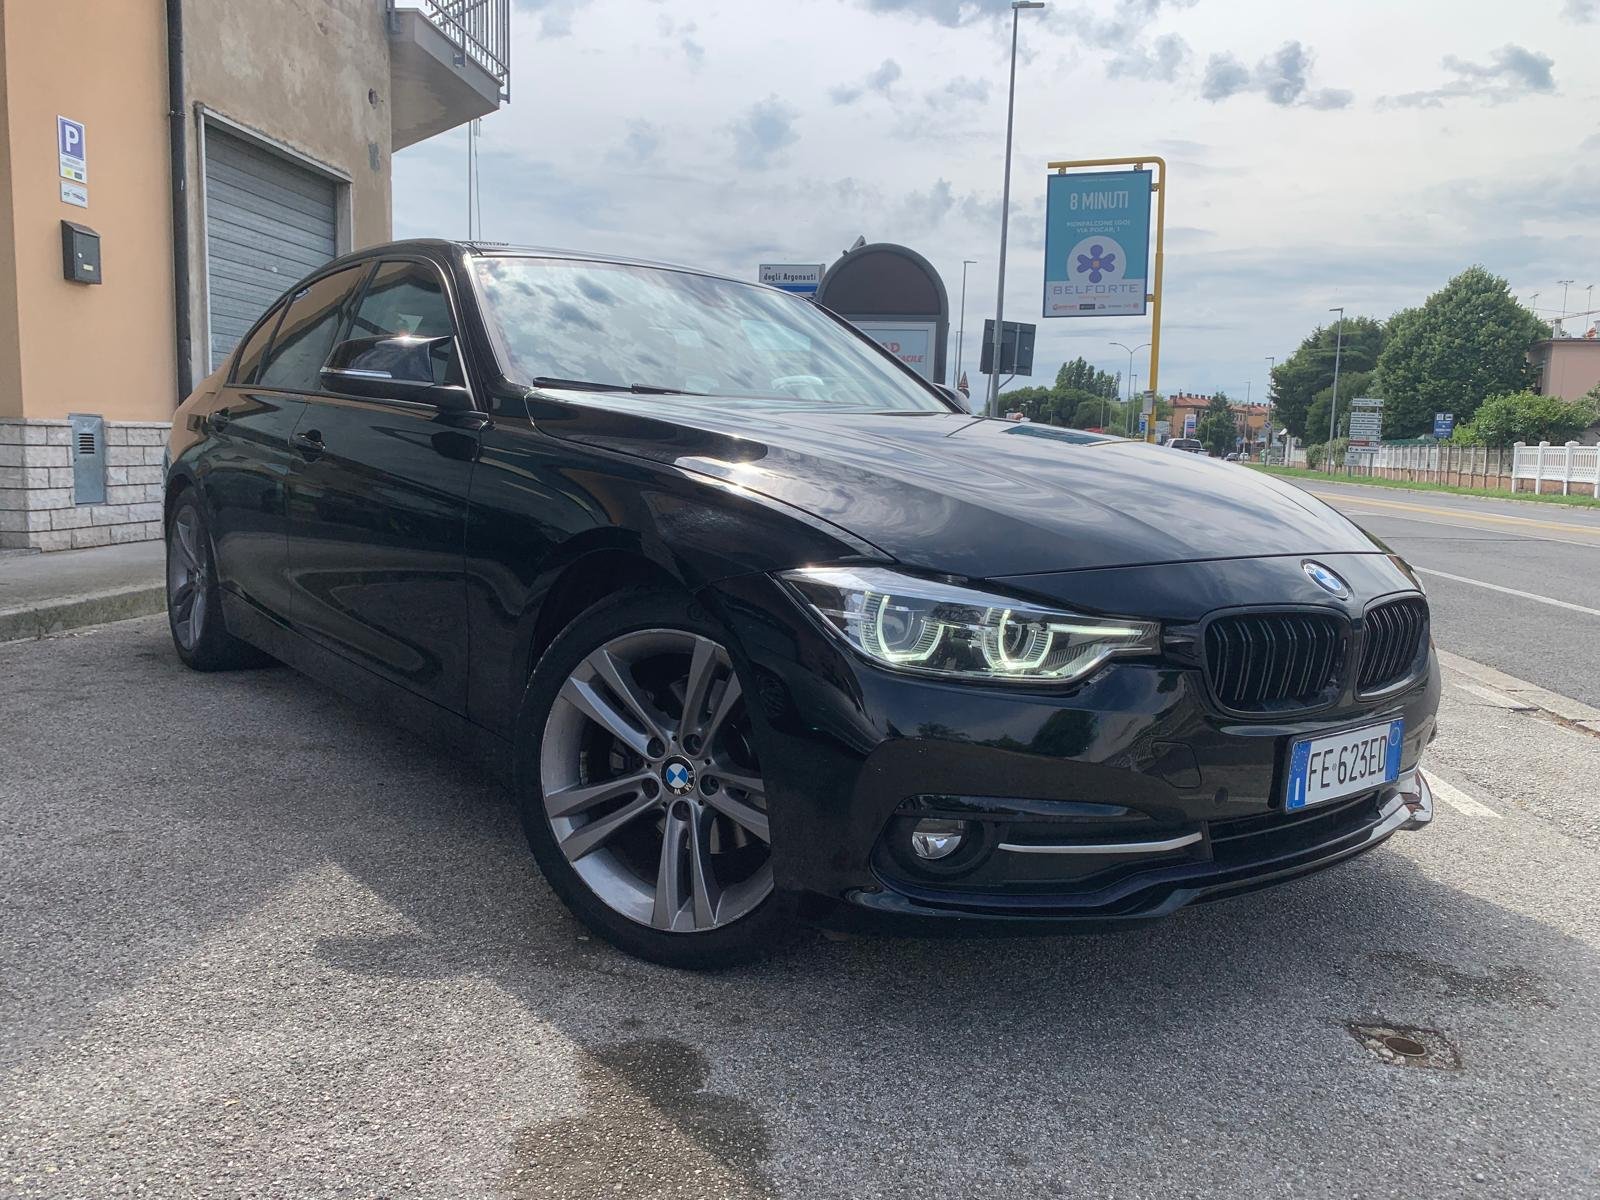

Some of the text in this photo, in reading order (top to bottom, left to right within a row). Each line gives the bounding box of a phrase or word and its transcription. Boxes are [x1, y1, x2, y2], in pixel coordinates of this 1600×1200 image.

[65, 125, 79, 152] P
[1070, 190, 1129, 210] 8 MINUTI
[763, 272, 816, 282] degli Argonauti
[1053, 283, 1140, 295] BELFORTE
